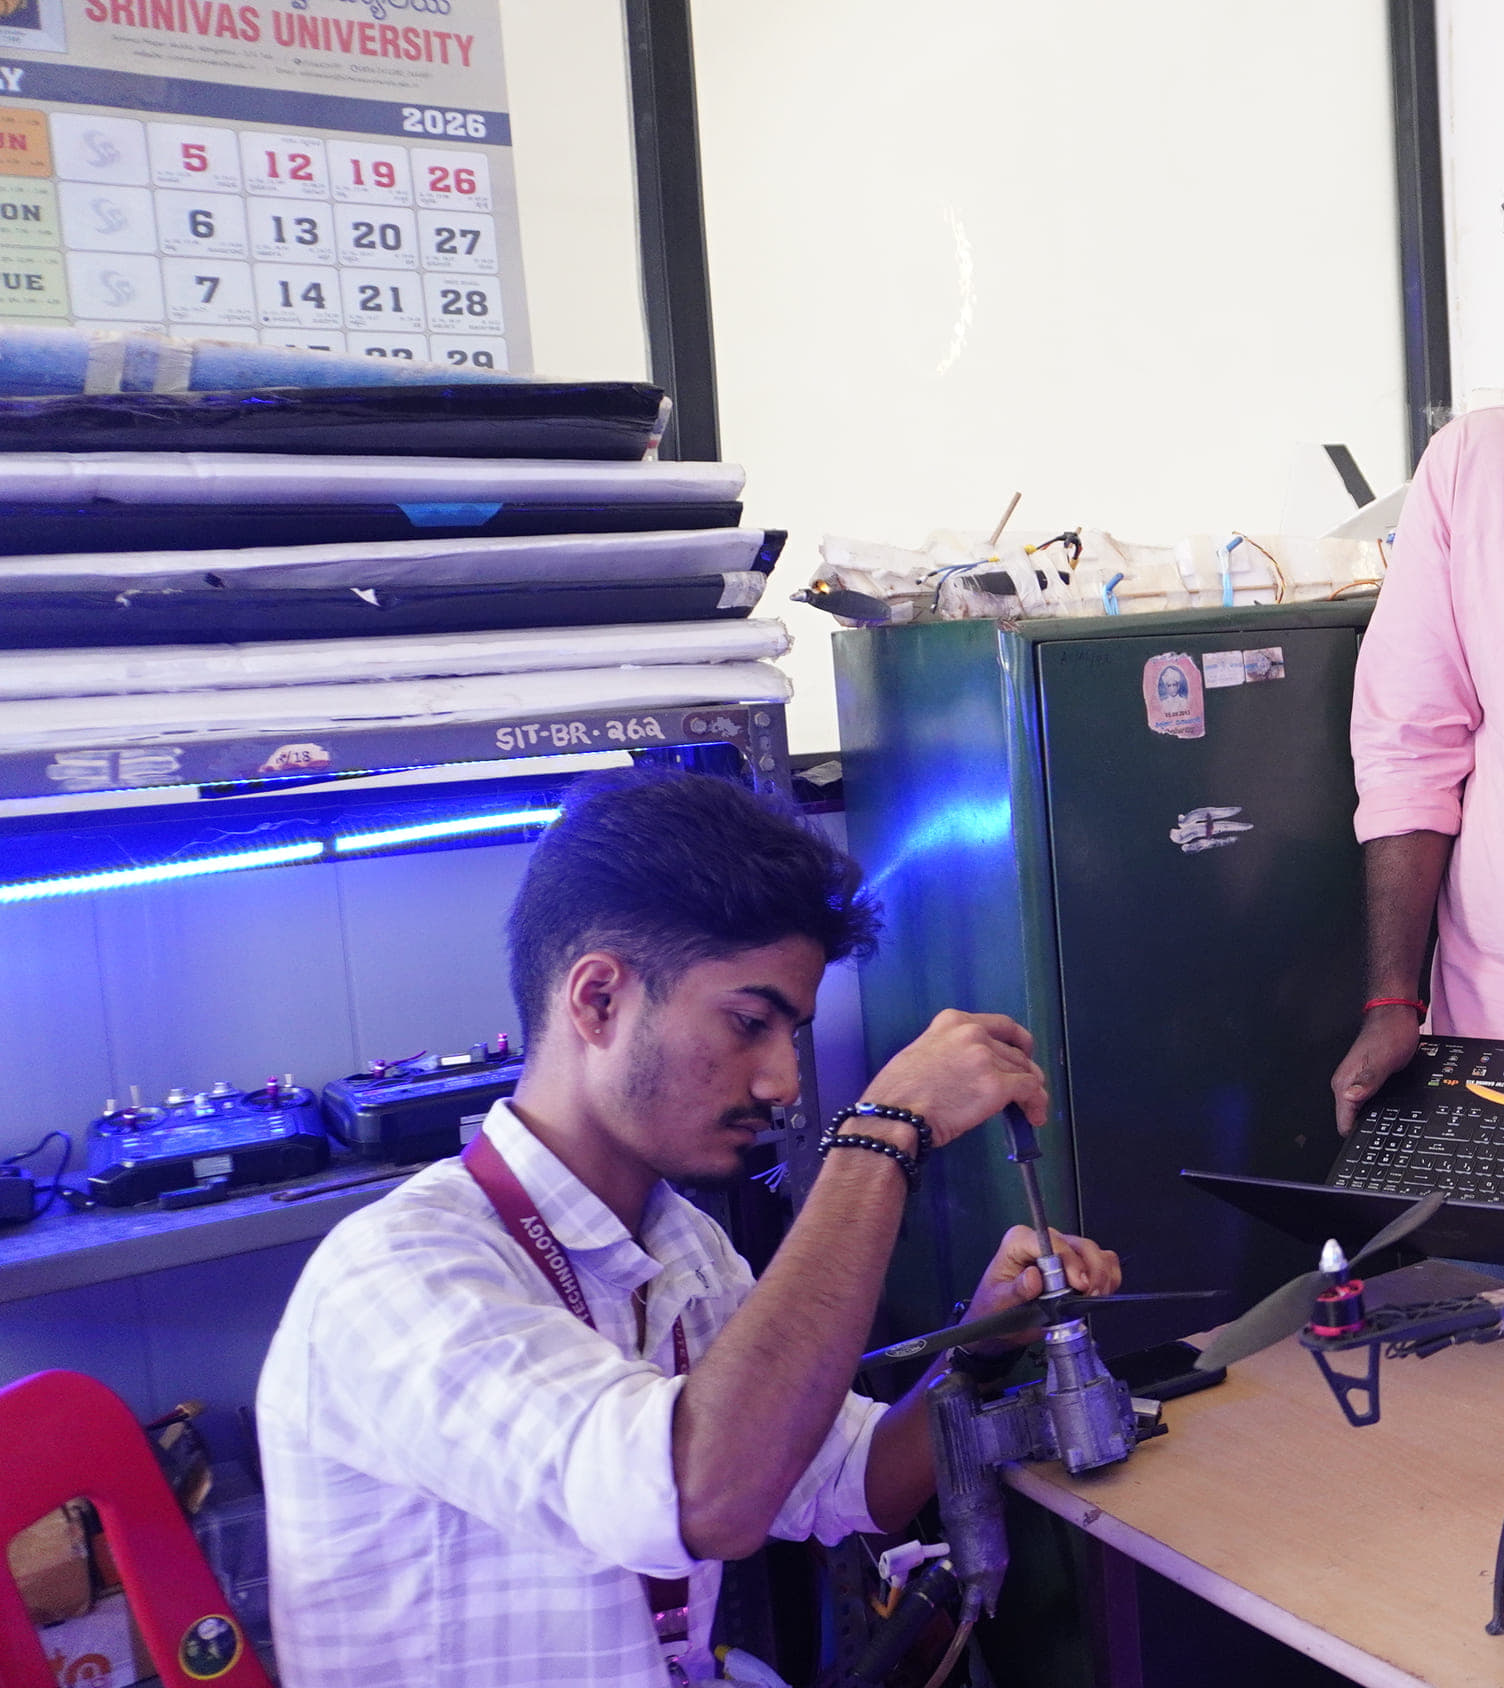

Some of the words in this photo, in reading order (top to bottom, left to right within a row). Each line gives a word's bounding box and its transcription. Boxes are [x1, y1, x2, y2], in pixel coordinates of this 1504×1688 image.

[85, 0, 260, 42] SRINIVAS
[272, 10, 475, 67] UNIVERSITY
[401, 106, 487, 138] 2026
[181, 142, 208, 172] 5
[264, 150, 314, 181] 12
[350, 158, 396, 188] 19
[427, 166, 477, 195] 26
[1, 203, 42, 222] ON
[188, 209, 215, 239] 6
[271, 215, 319, 246] 13
[352, 221, 401, 251] 20
[434, 227, 482, 255] 27
[2, 273, 45, 292] UE
[194, 275, 221, 304] 7
[278, 280, 326, 309] 14
[358, 285, 404, 313] 21
[440, 289, 489, 317] 28
[519, 1214, 590, 1322] TECHNOLOGY
